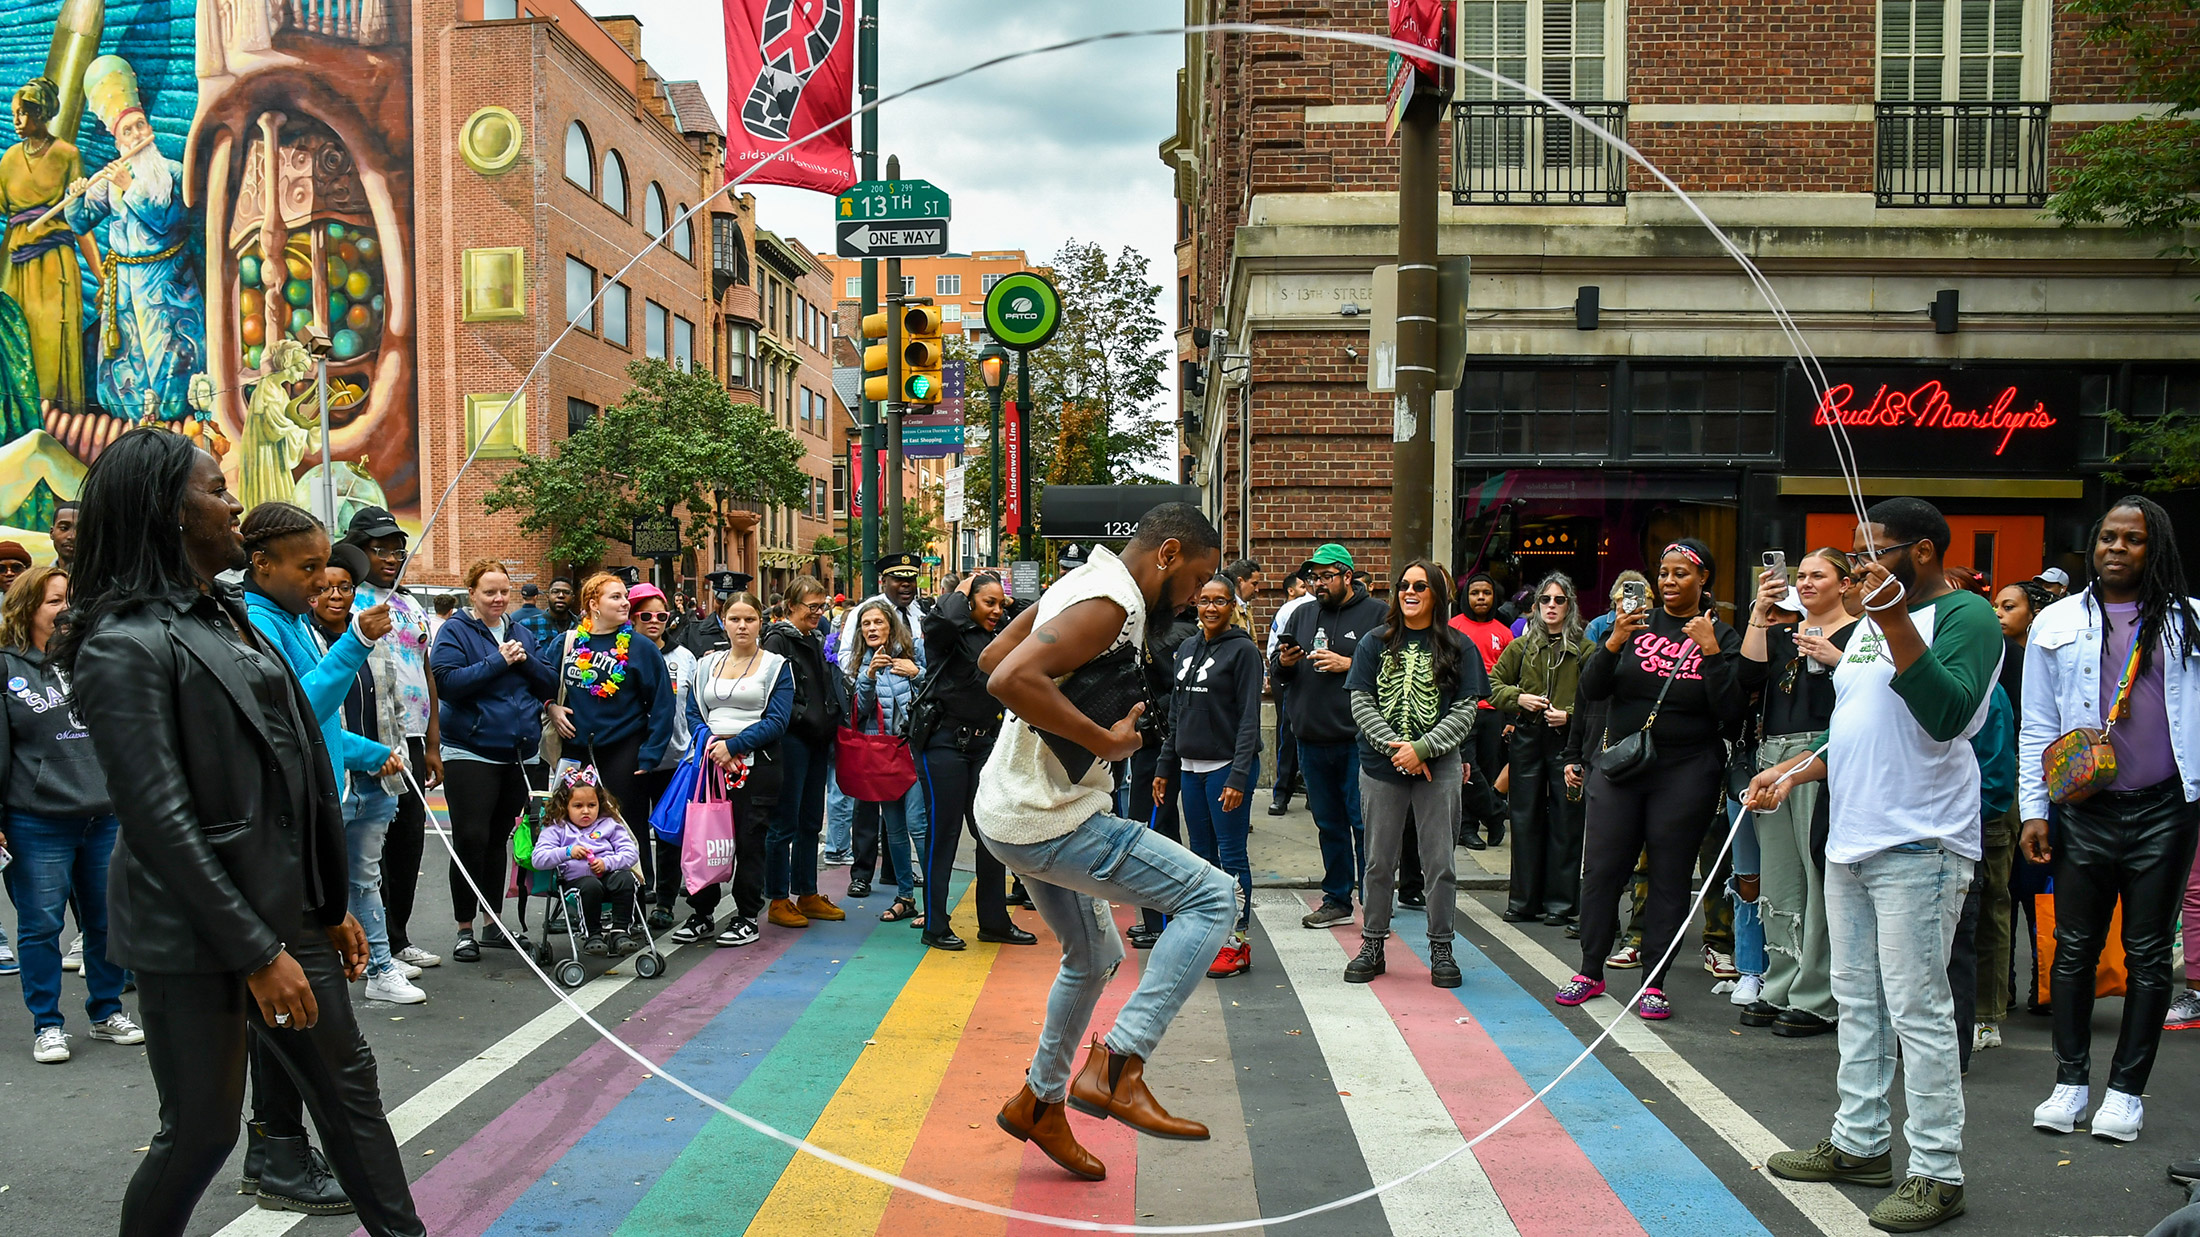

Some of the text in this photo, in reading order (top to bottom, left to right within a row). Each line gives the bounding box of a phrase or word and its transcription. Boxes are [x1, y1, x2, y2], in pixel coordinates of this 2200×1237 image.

[870, 183, 913, 194] 200 S 299
[924, 200, 939, 215] ST
[869, 230, 935, 245] ONE WAY
[1908, 380, 2057, 455] Marilyn's
[1009, 421, 1017, 442] Line
[1009, 444, 1017, 498] Lindenwold
[592, 651, 618, 676] CITY
